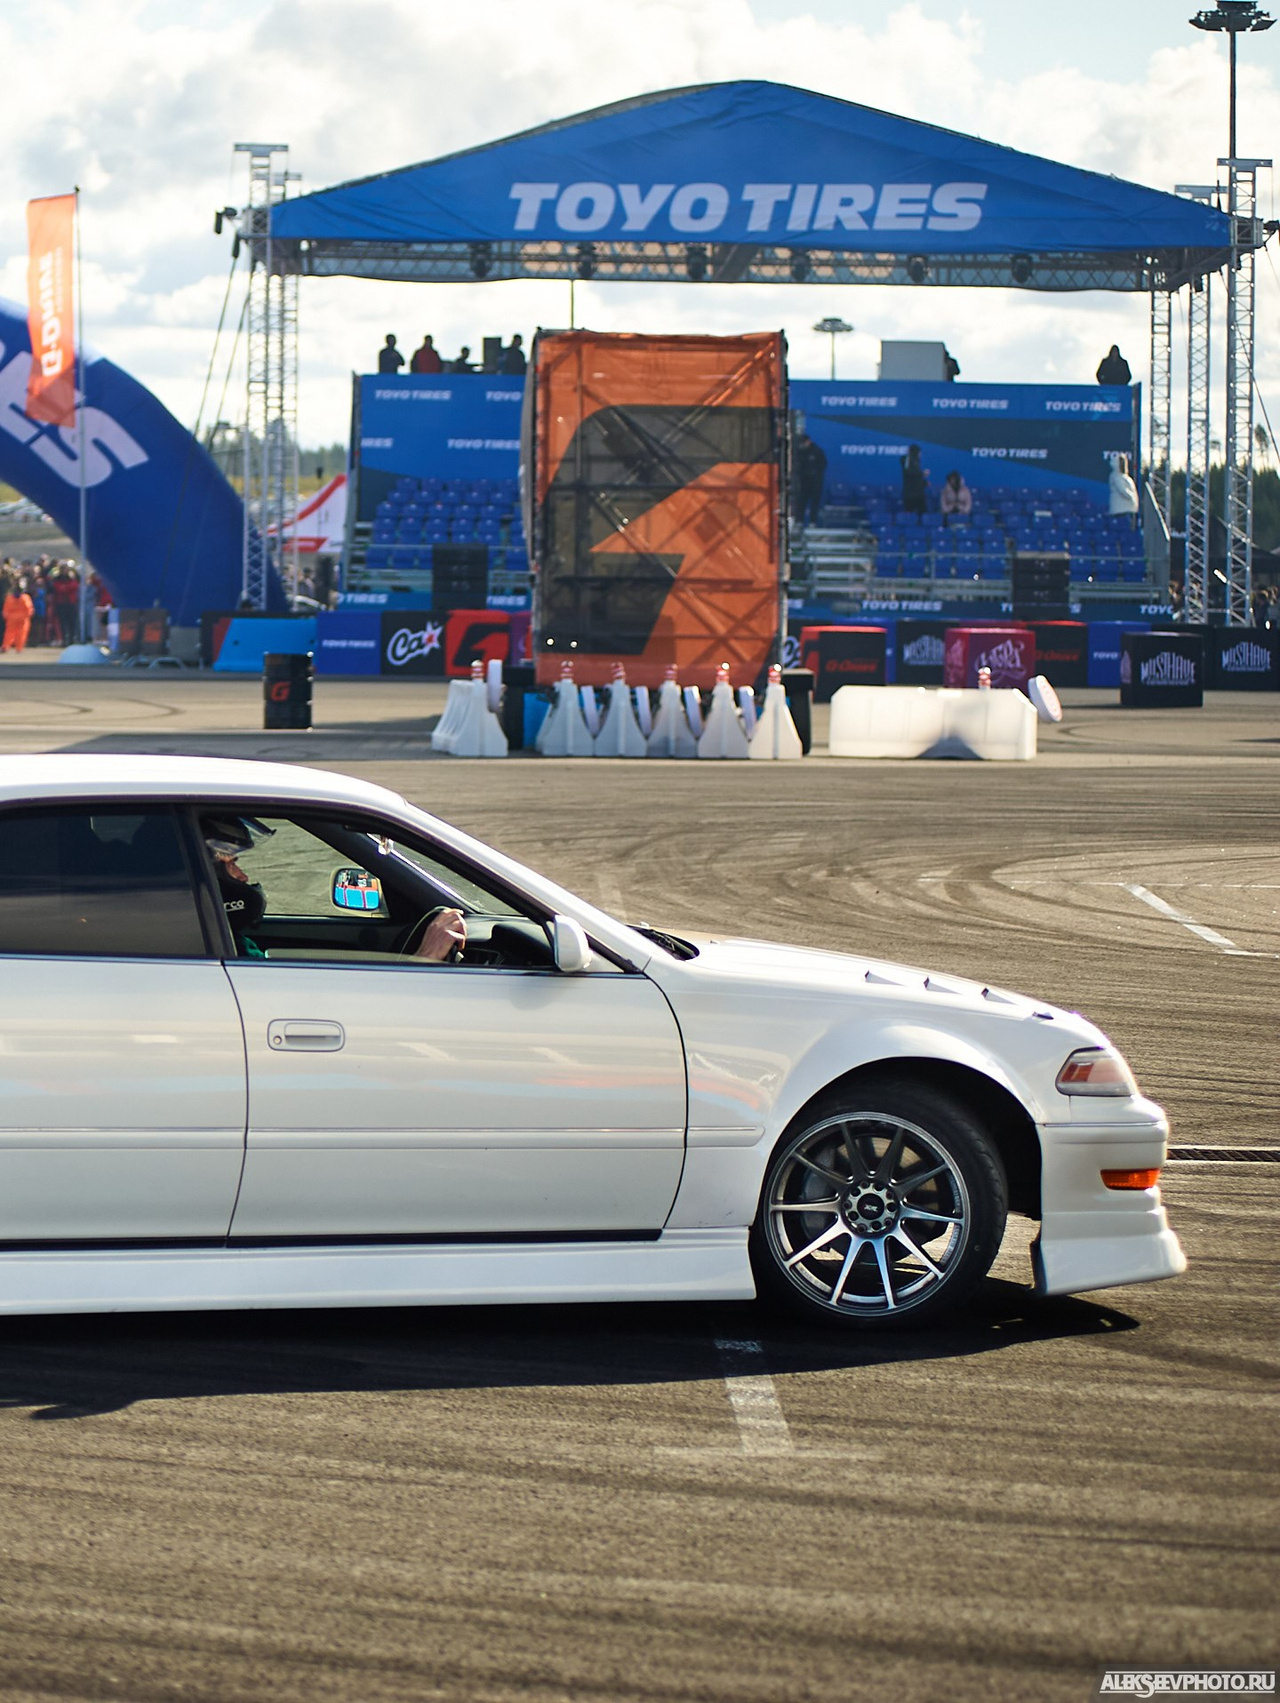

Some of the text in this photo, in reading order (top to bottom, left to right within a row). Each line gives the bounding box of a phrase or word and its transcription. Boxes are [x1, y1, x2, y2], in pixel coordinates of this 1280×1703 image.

[510, 182, 987, 232] TOYO TIRES
[375, 390, 452, 400] TOYO TIRES
[821, 396, 898, 407] TOYO TIRES
[932, 398, 1009, 410] TOYO TIRES
[1045, 401, 1121, 412] TOYO TIRES
[447, 439, 484, 449] TOYO
[841, 445, 909, 455] TOYO TIRE
[972, 447, 1048, 459] TOYO TIRES
[346, 593, 388, 604] TIRES
[862, 600, 942, 611] TOYO TIRES
